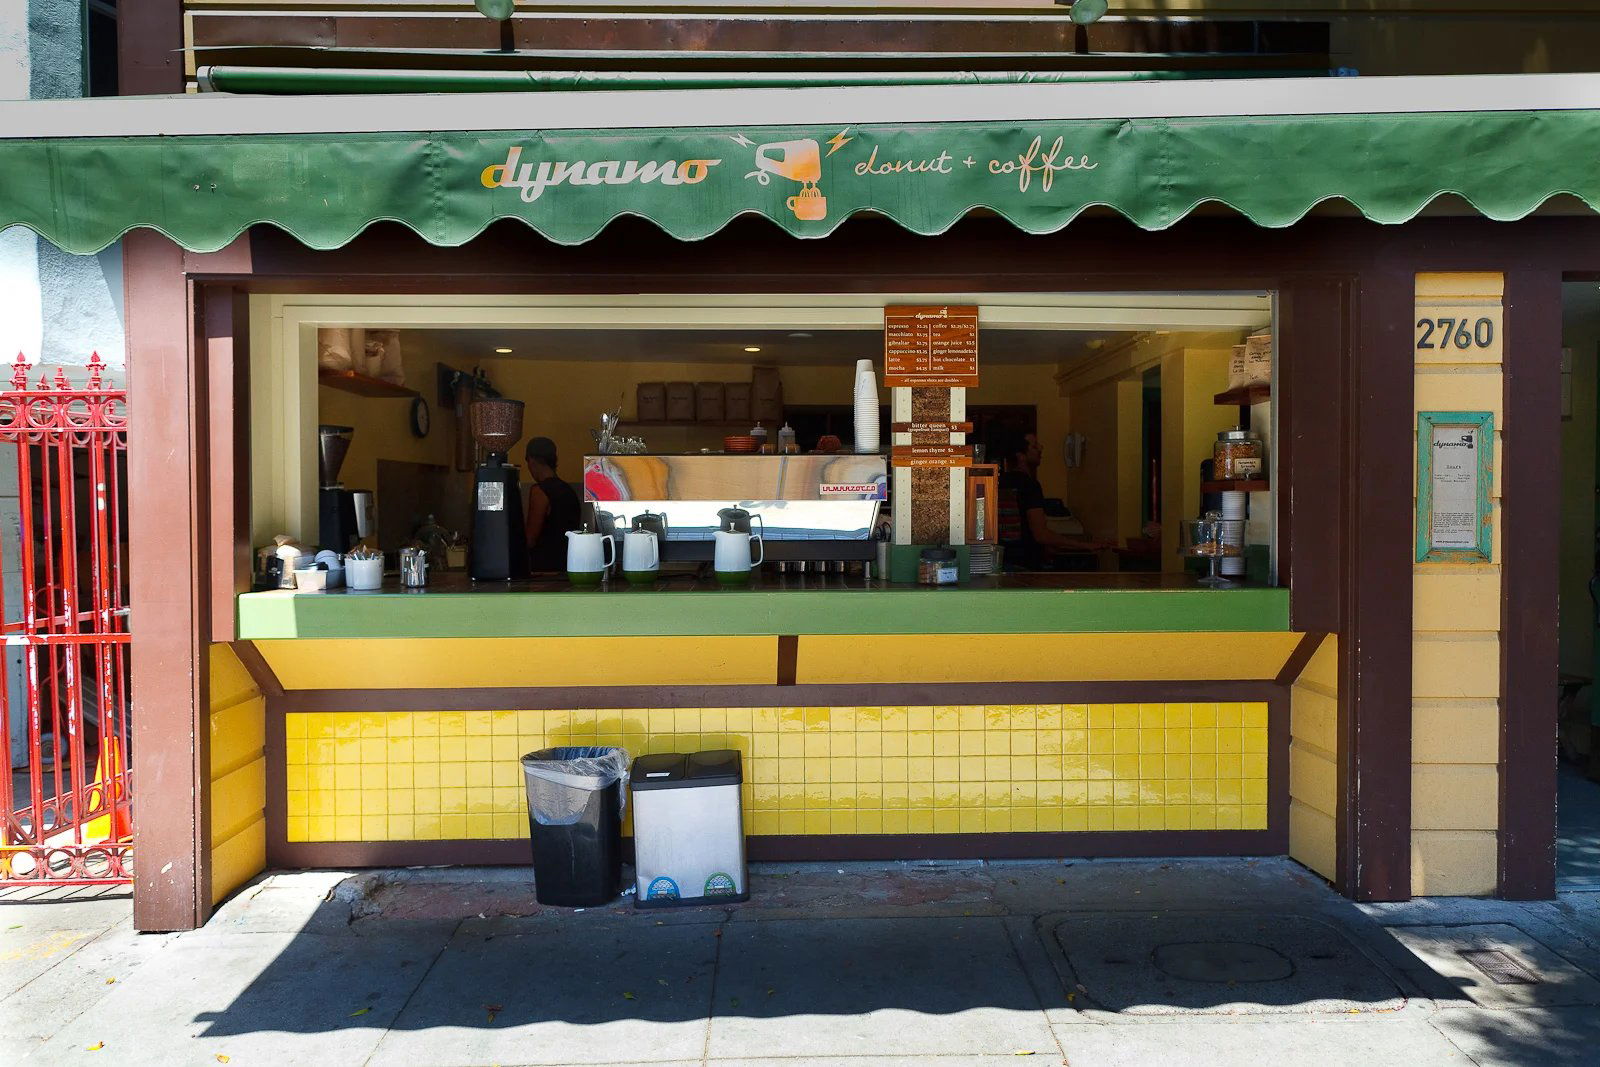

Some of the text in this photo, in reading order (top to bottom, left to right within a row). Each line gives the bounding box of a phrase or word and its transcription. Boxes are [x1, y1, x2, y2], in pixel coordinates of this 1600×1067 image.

[480, 146, 722, 203] dynamo
[855, 144, 952, 176] donut
[988, 135, 1098, 192] coffee
[915, 312, 944, 320] dynamo
[1416, 317, 1494, 349] 2760
[1433, 440, 1468, 449] dynamo
